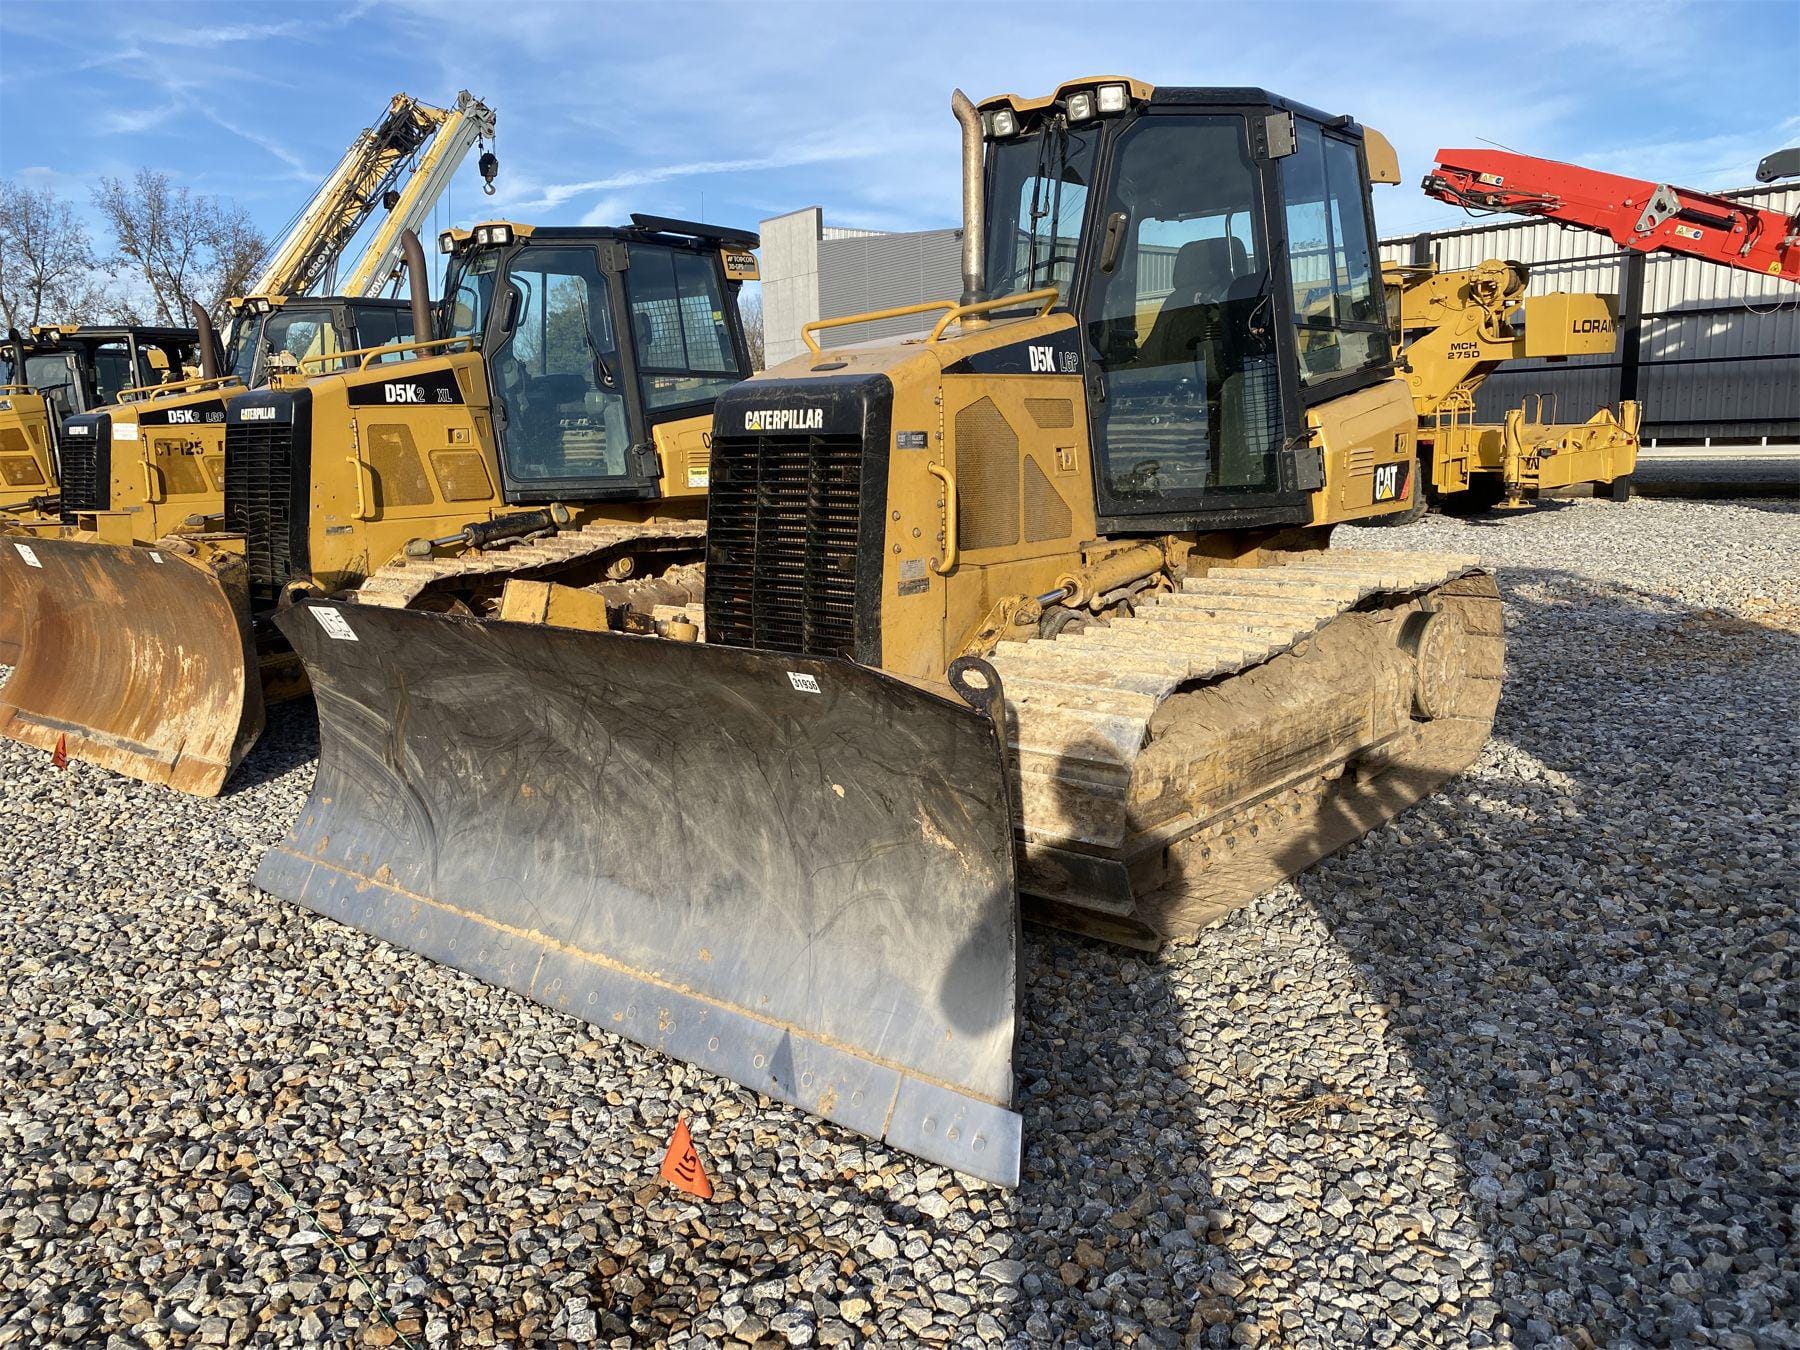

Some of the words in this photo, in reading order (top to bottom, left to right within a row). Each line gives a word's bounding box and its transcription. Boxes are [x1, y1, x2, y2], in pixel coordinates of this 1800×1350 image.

[307, 241, 337, 277] GROVE
[367, 271, 387, 298] ROVE
[1447, 350, 1480, 359] 275D
[1450, 341, 1477, 350] MCH
[1028, 345, 1056, 372] D5K
[1058, 351, 1079, 373] LGP
[437, 388, 453, 403] XL
[205, 411, 225, 423] LGP
[240, 407, 276, 420] CATERPILLAR
[744, 408, 824, 430] CATERPILLAR
[1375, 465, 1398, 500] CAT
[674, 1141, 698, 1183] 115
